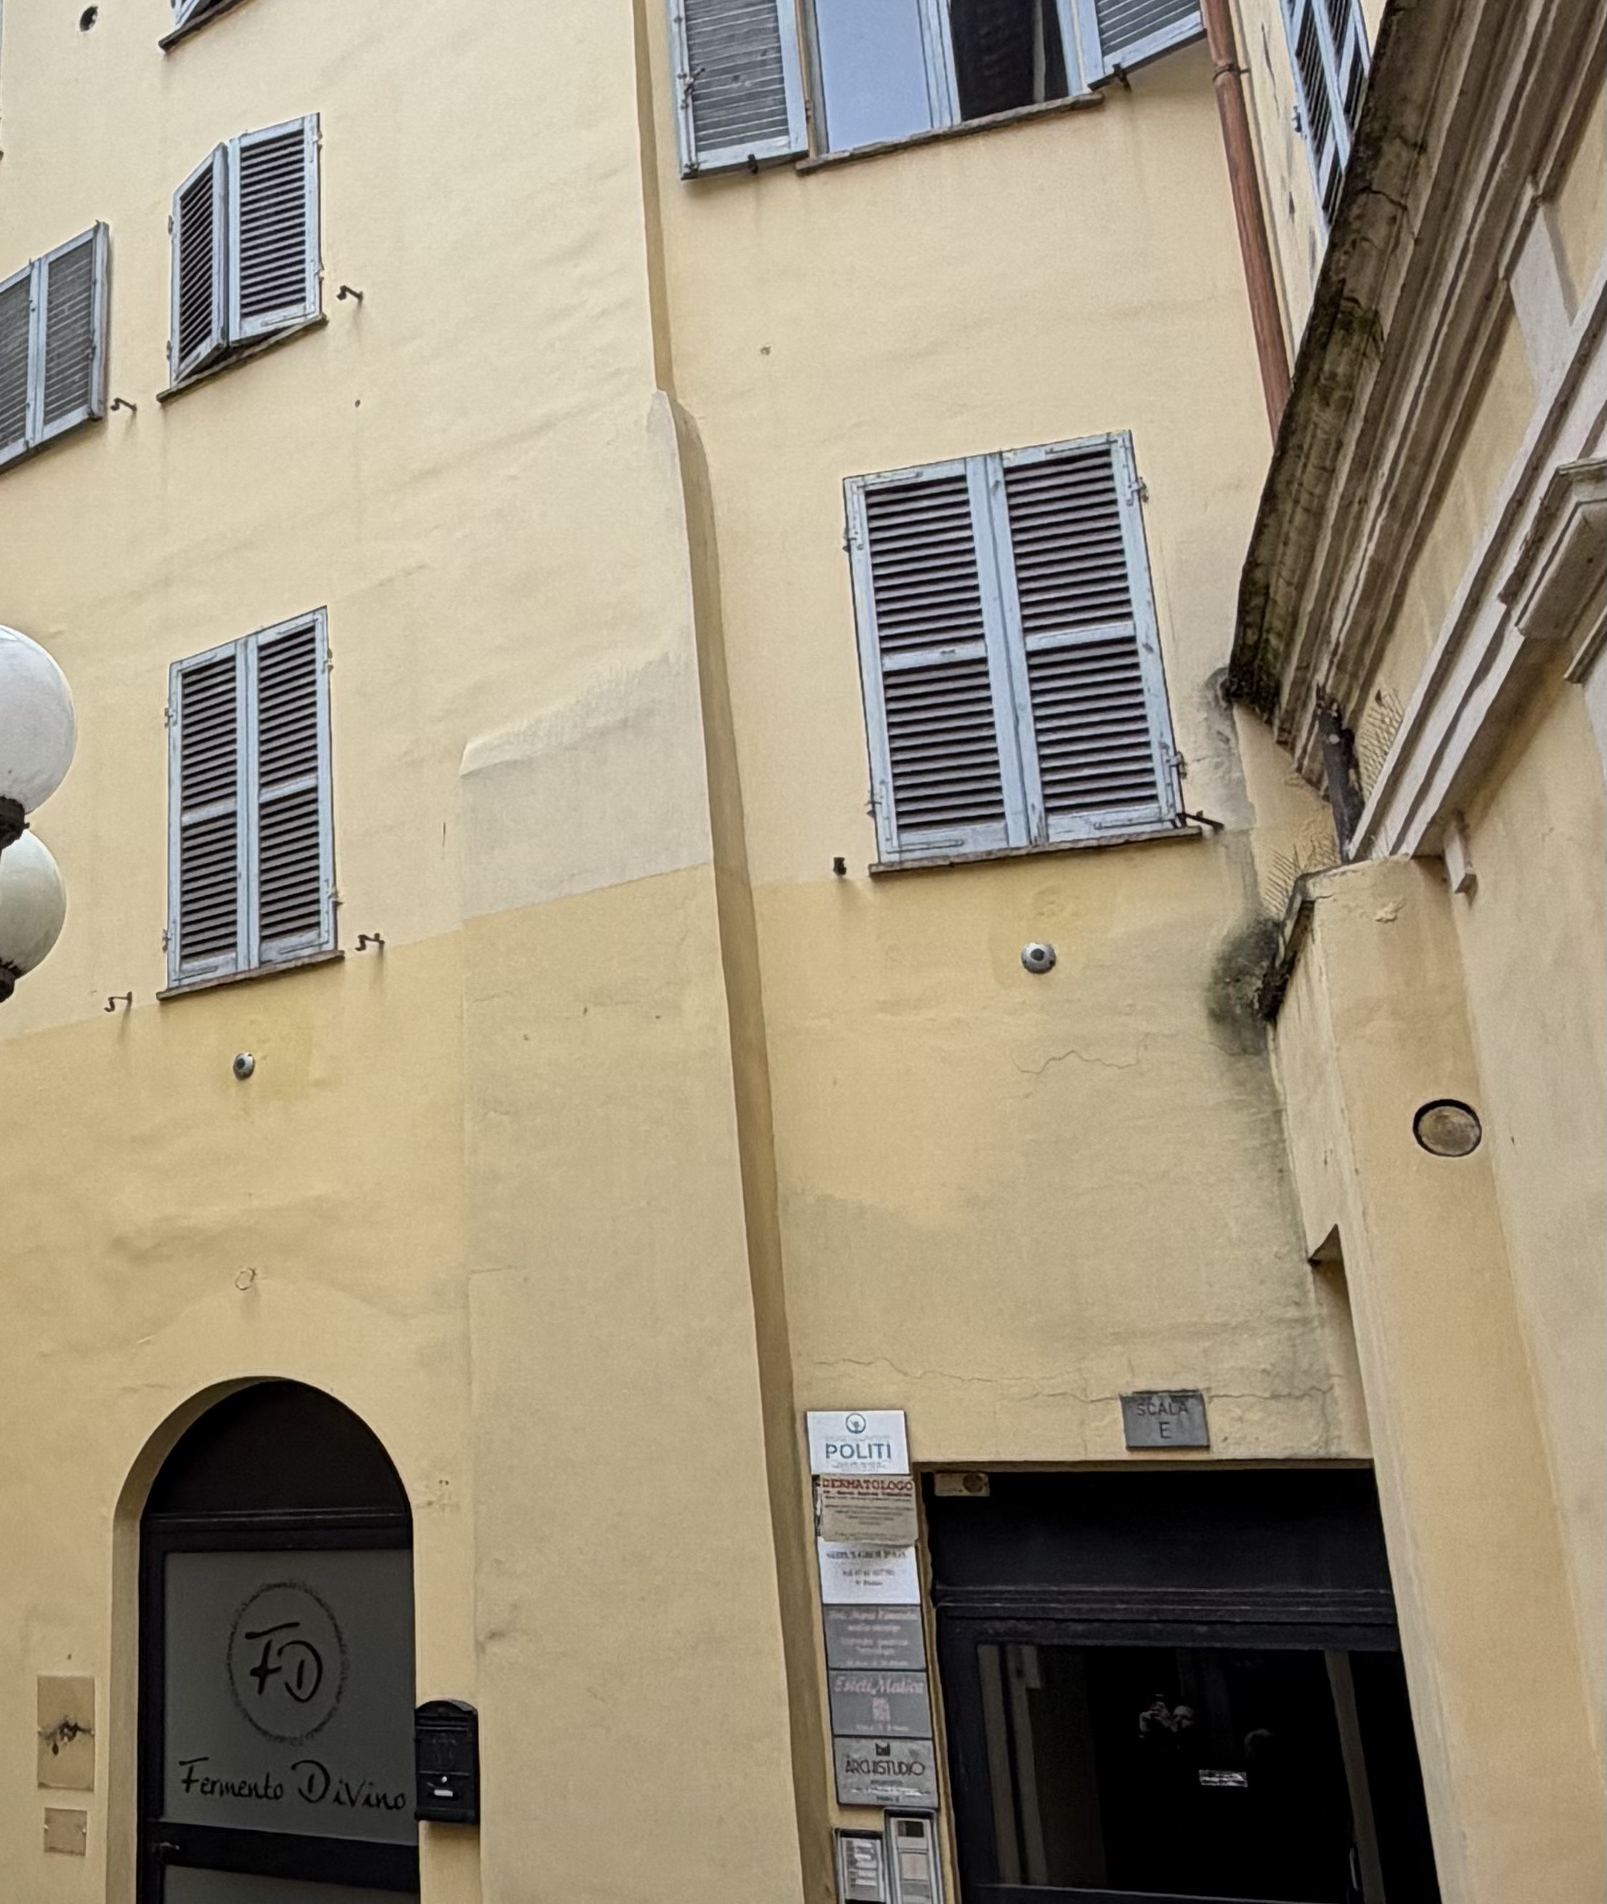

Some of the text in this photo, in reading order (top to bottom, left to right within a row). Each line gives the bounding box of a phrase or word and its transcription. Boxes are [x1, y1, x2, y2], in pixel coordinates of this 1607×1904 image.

[1137, 1400, 1189, 1417] SCALA
[1158, 1421, 1172, 1439] E
[825, 1442, 892, 1460] POLITI
[822, 1478, 913, 1491] DERMATOLOGO
[178, 1756, 284, 1800] Fermento
